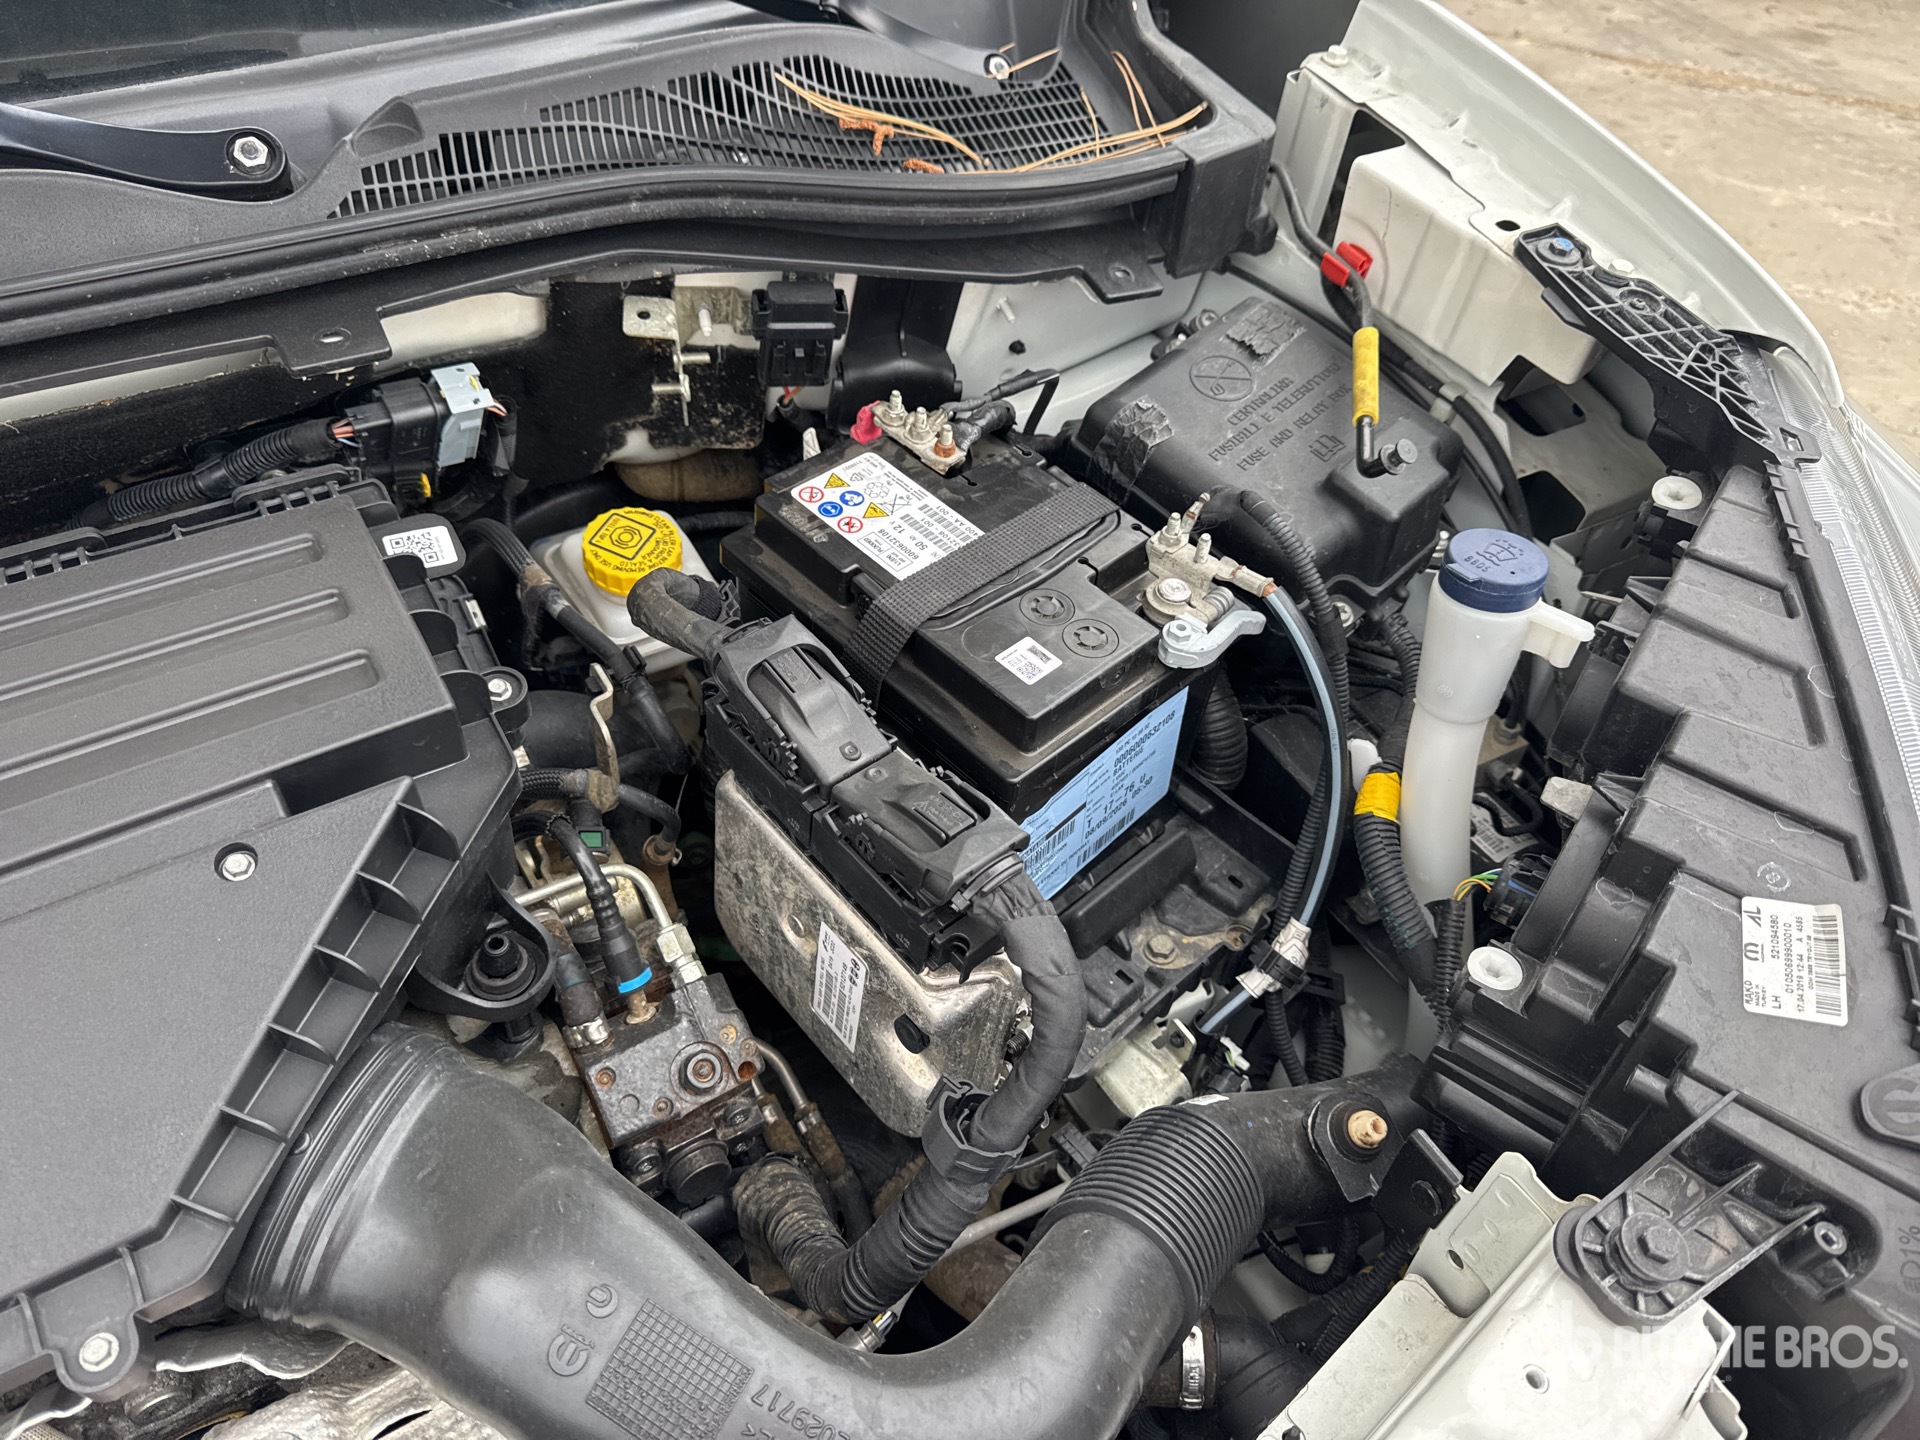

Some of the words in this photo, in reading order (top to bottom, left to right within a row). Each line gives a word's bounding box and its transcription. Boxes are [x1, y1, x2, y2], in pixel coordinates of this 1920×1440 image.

[1261, 410, 1276, 423] E
[1236, 446, 1271, 471] FUSE
[1269, 428, 1294, 448] AND
[1293, 400, 1330, 429] RELAY
[936, 505, 950, 515] 001
[893, 524, 906, 534] 12
[920, 518, 934, 528] 001
[954, 518, 966, 527] AA
[877, 528, 920, 560] 6000632108
[915, 541, 929, 552] 50
[1114, 710, 1176, 768] 0006000632108
[1112, 745, 1144, 777] BATTERIE
[1086, 817, 1093, 828] T
[1770, 914, 1780, 960] 521094580
[1796, 954, 1804, 974] 12:44
[1796, 975, 1805, 1013] 17.04.2019
[1772, 995, 1782, 1010] LH
